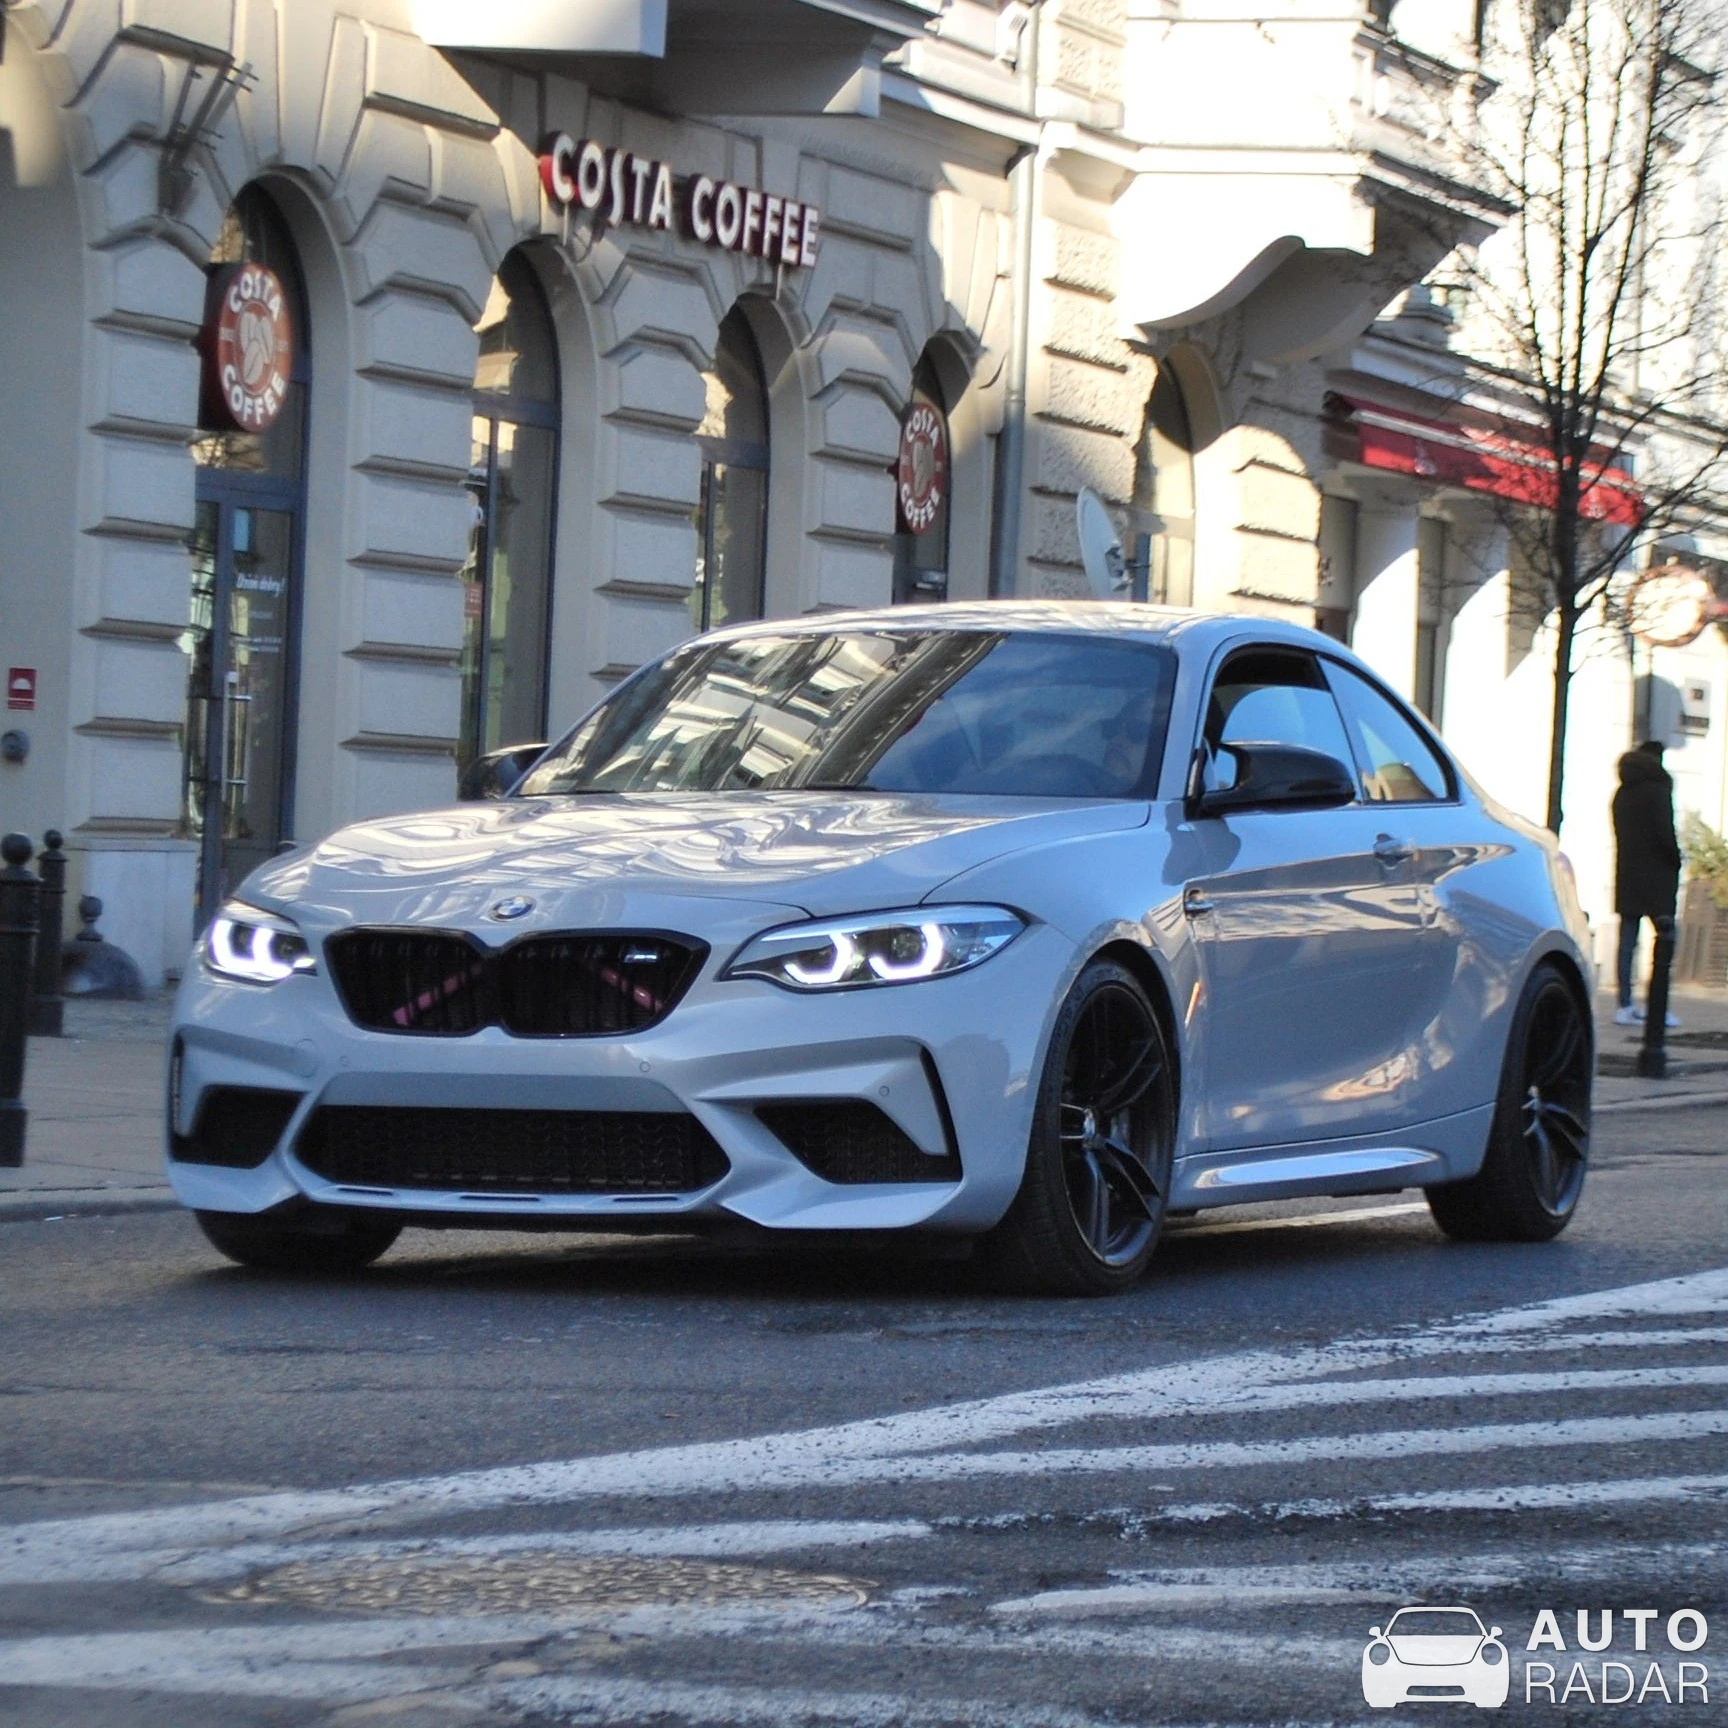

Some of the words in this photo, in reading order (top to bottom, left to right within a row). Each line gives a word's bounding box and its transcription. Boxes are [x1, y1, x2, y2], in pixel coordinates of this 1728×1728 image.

[550, 133, 672, 229] COSTA
[691, 176, 820, 267] COFFEE
[230, 271, 282, 322] COSTA
[223, 364, 286, 424] COFFEE
[906, 409, 940, 447] COSTA
[901, 483, 940, 529] COFFEE
